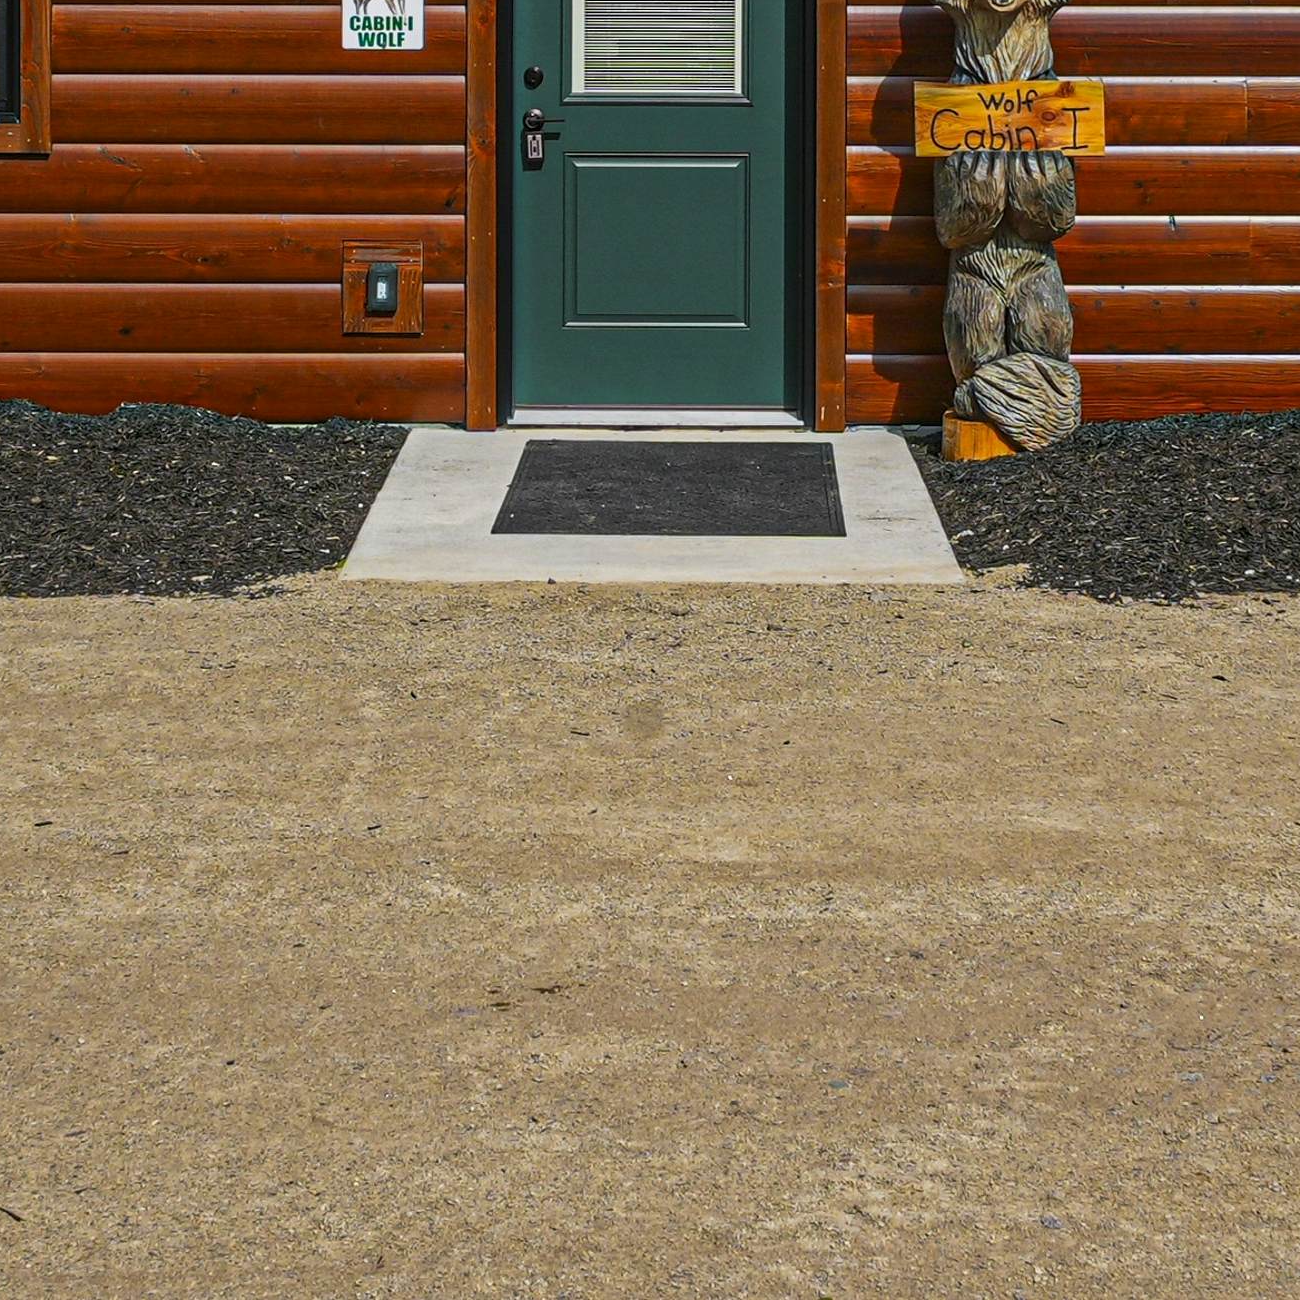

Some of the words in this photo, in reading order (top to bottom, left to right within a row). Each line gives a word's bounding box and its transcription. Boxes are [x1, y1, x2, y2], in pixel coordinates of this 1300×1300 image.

[349, 15, 403, 31] CABIN
[357, 32, 406, 47] WOLF
[977, 88, 1039, 113] Wolf
[930, 108, 1039, 151] Cabin
[1061, 107, 1090, 150] I
